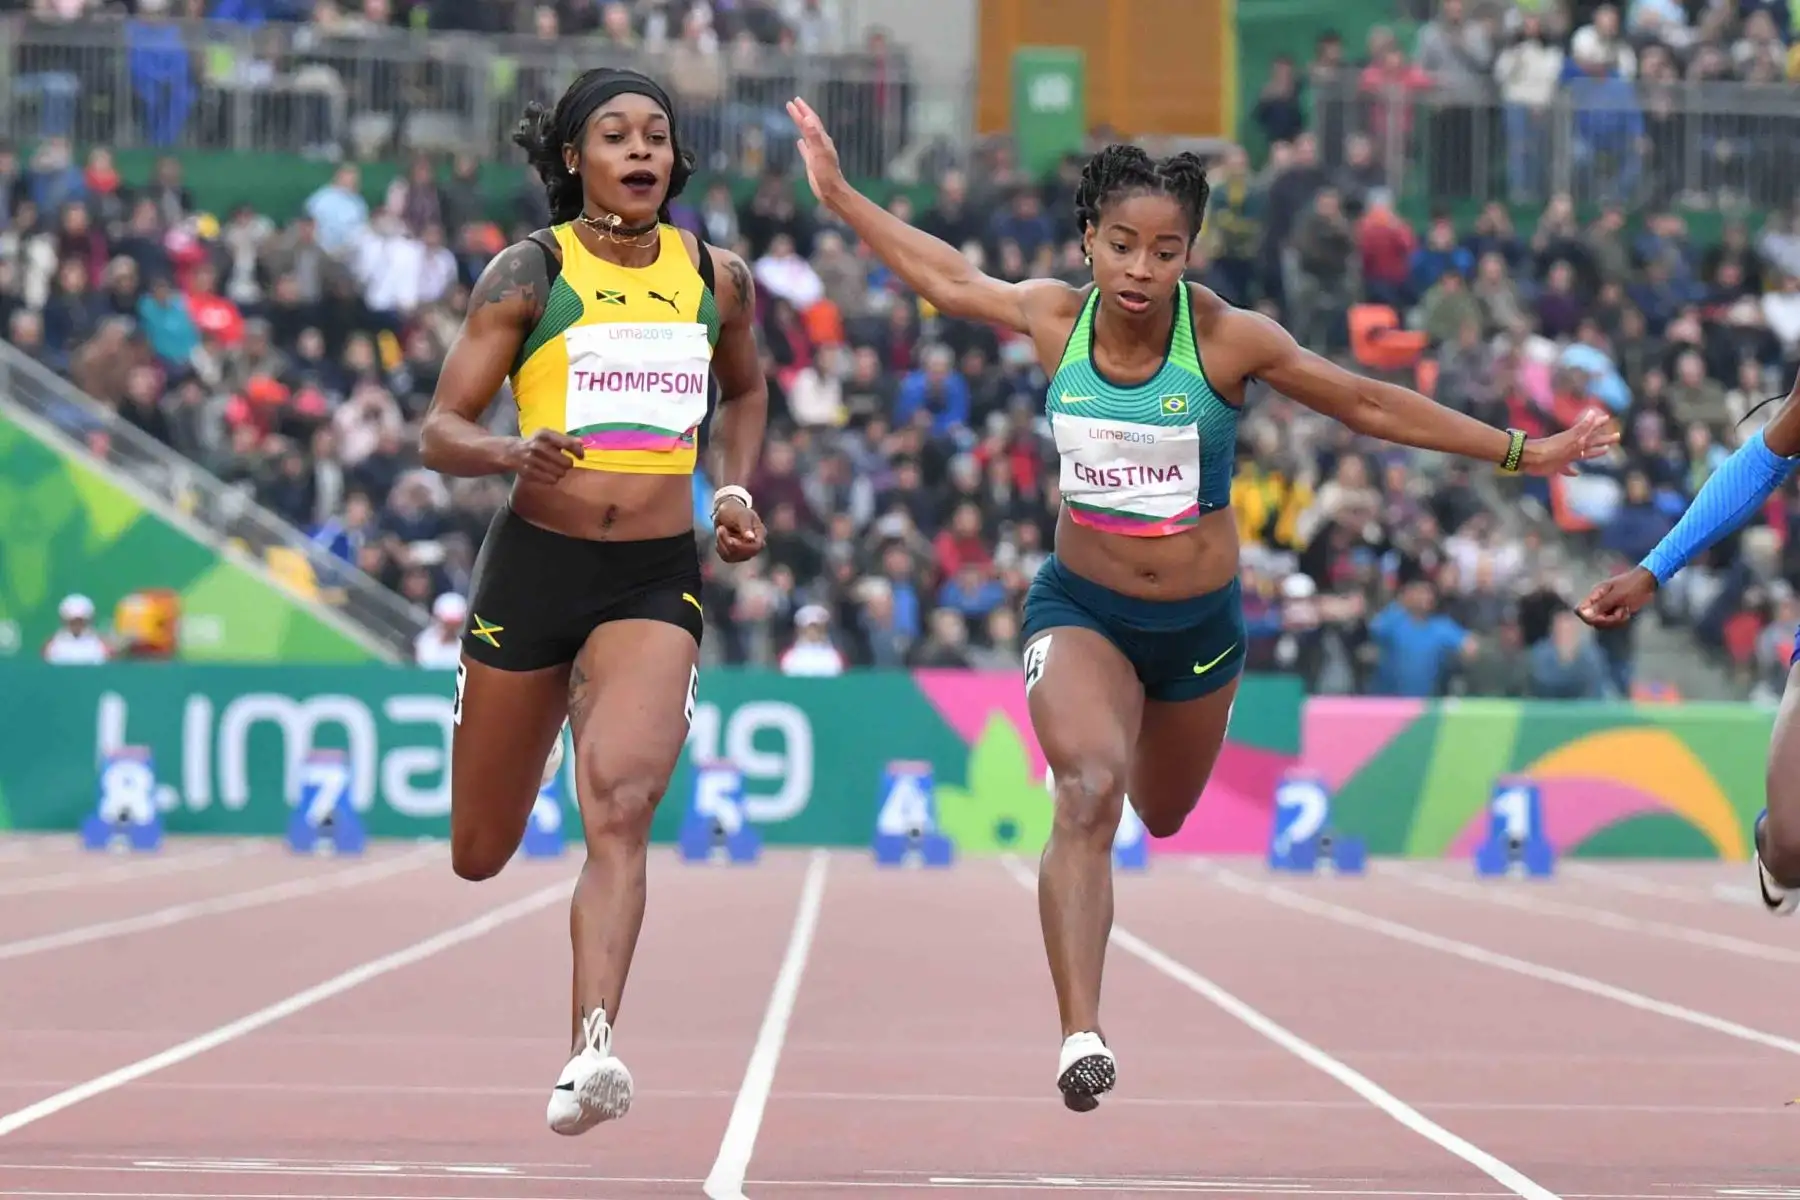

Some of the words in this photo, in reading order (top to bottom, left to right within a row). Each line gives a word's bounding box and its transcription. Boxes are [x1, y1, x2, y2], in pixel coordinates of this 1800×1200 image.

[573, 370, 704, 395] THOMPSON
[1073, 461, 1184, 488] CRISTINA
[101, 759, 155, 826] 8
[300, 765, 352, 829] 7
[695, 771, 744, 837] 5
[878, 775, 936, 835] 4
[1275, 780, 1328, 858] 2
[1492, 785, 1531, 839] 1
